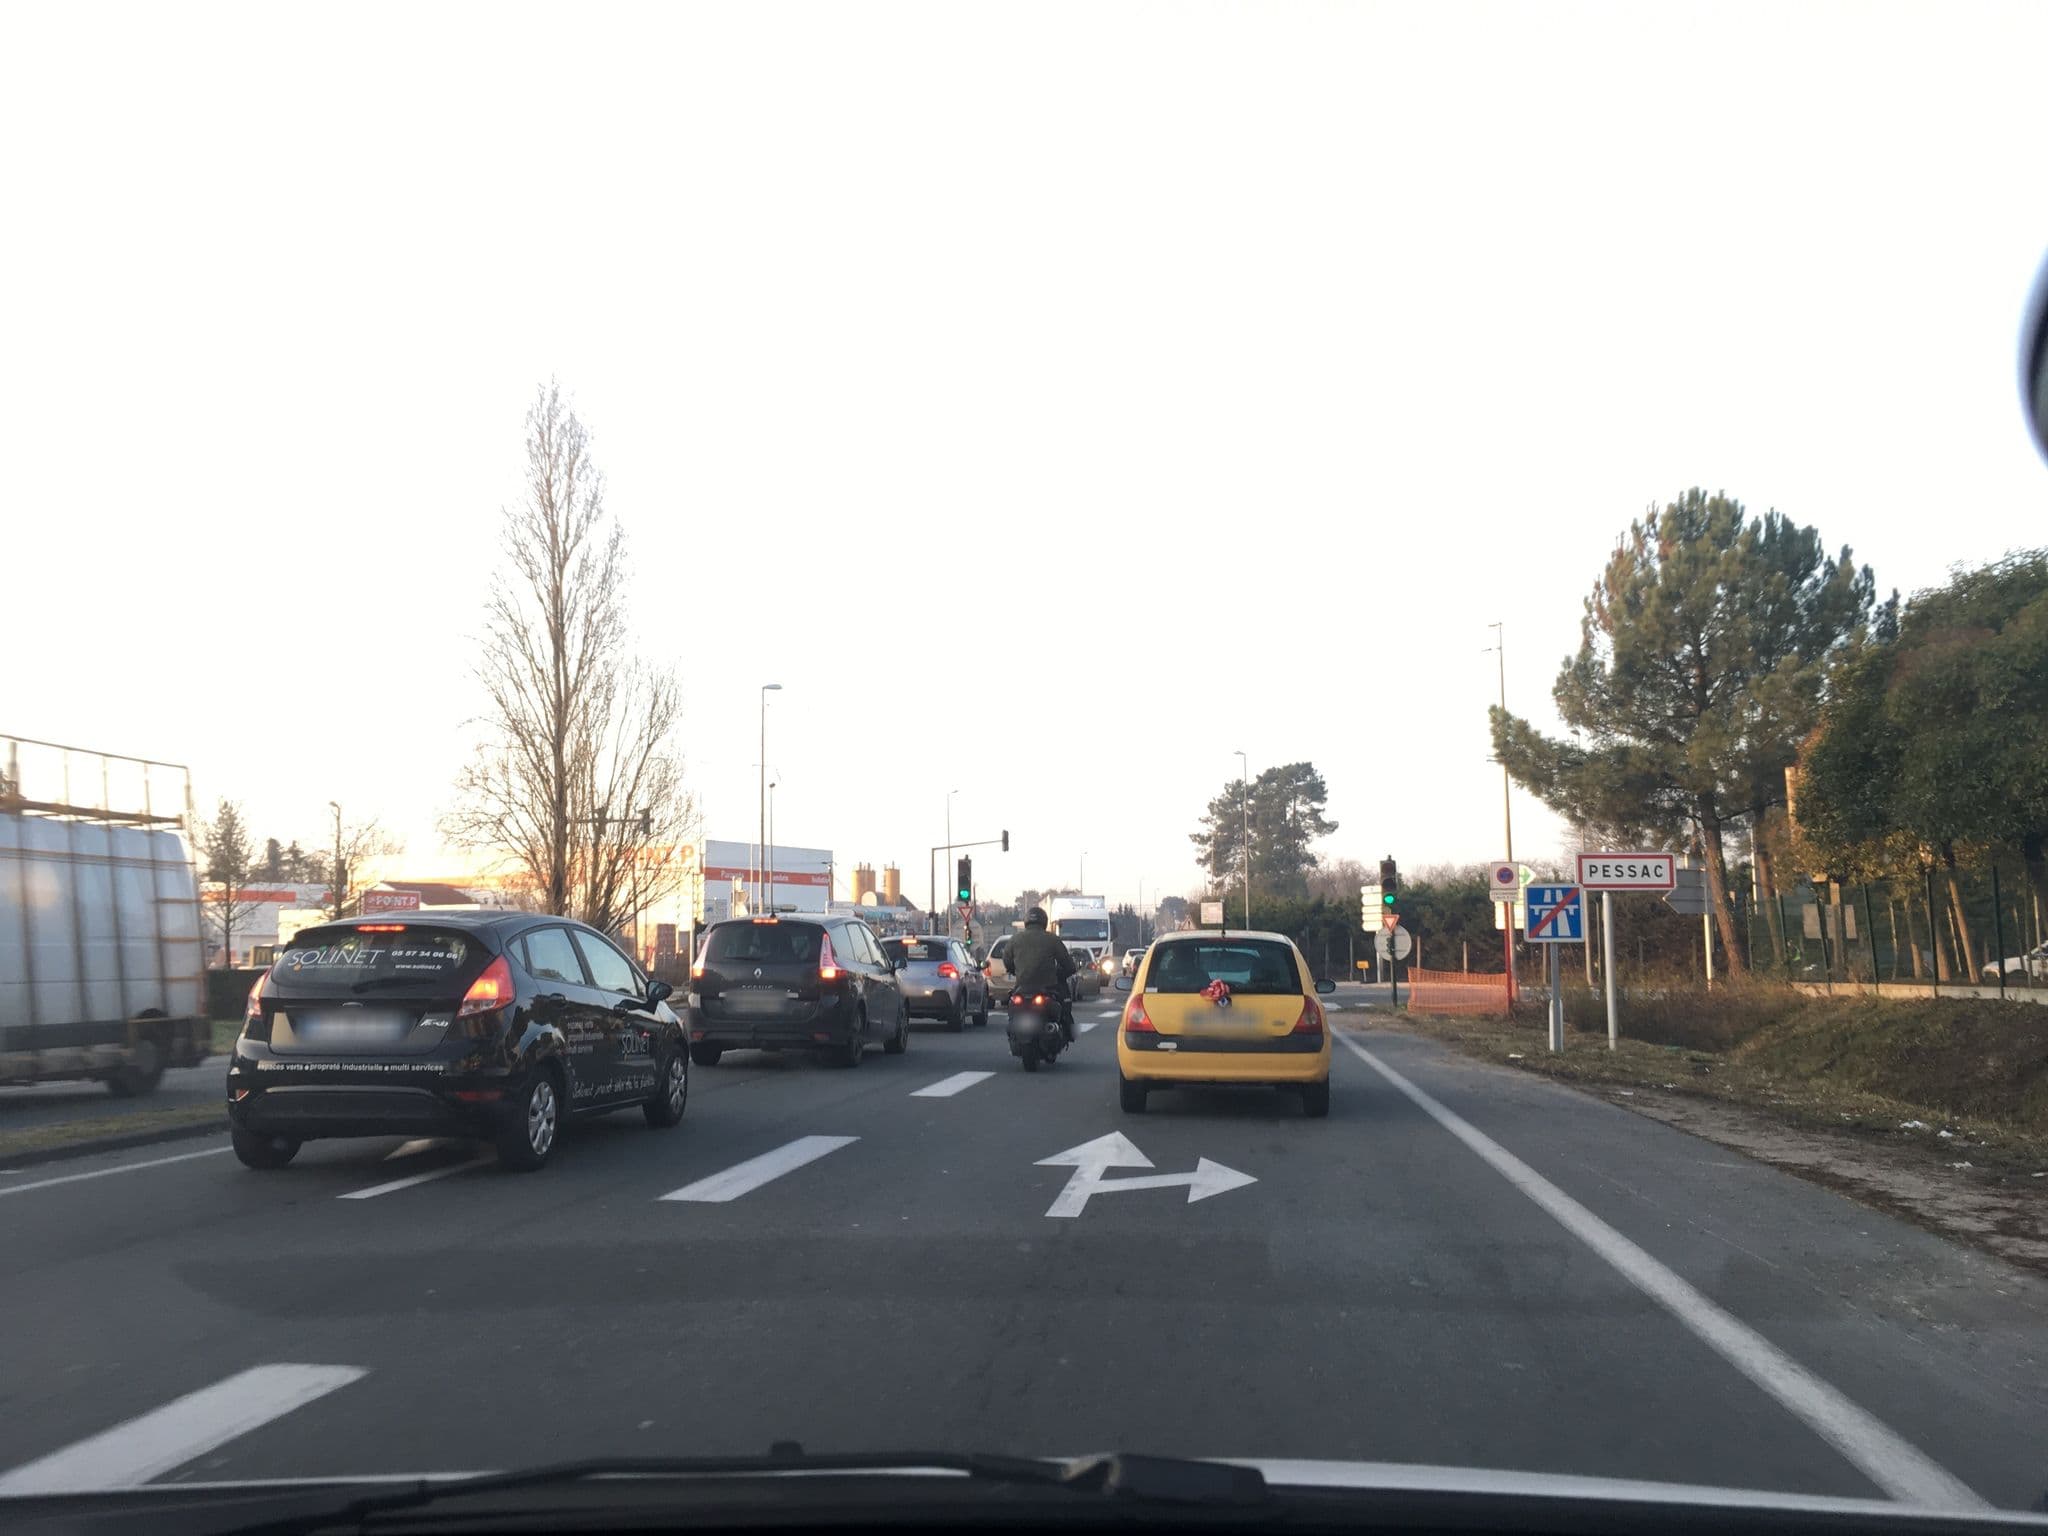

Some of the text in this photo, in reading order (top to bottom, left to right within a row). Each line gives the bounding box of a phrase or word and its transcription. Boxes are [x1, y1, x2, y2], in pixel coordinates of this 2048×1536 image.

[1588, 864, 1664, 878] PESSAC
[288, 949, 386, 966] SOLINET
[309, 1062, 341, 1073] propreté
[342, 1063, 384, 1072] industrielle
[390, 1064, 411, 1072] multi
[411, 1064, 445, 1072] services
